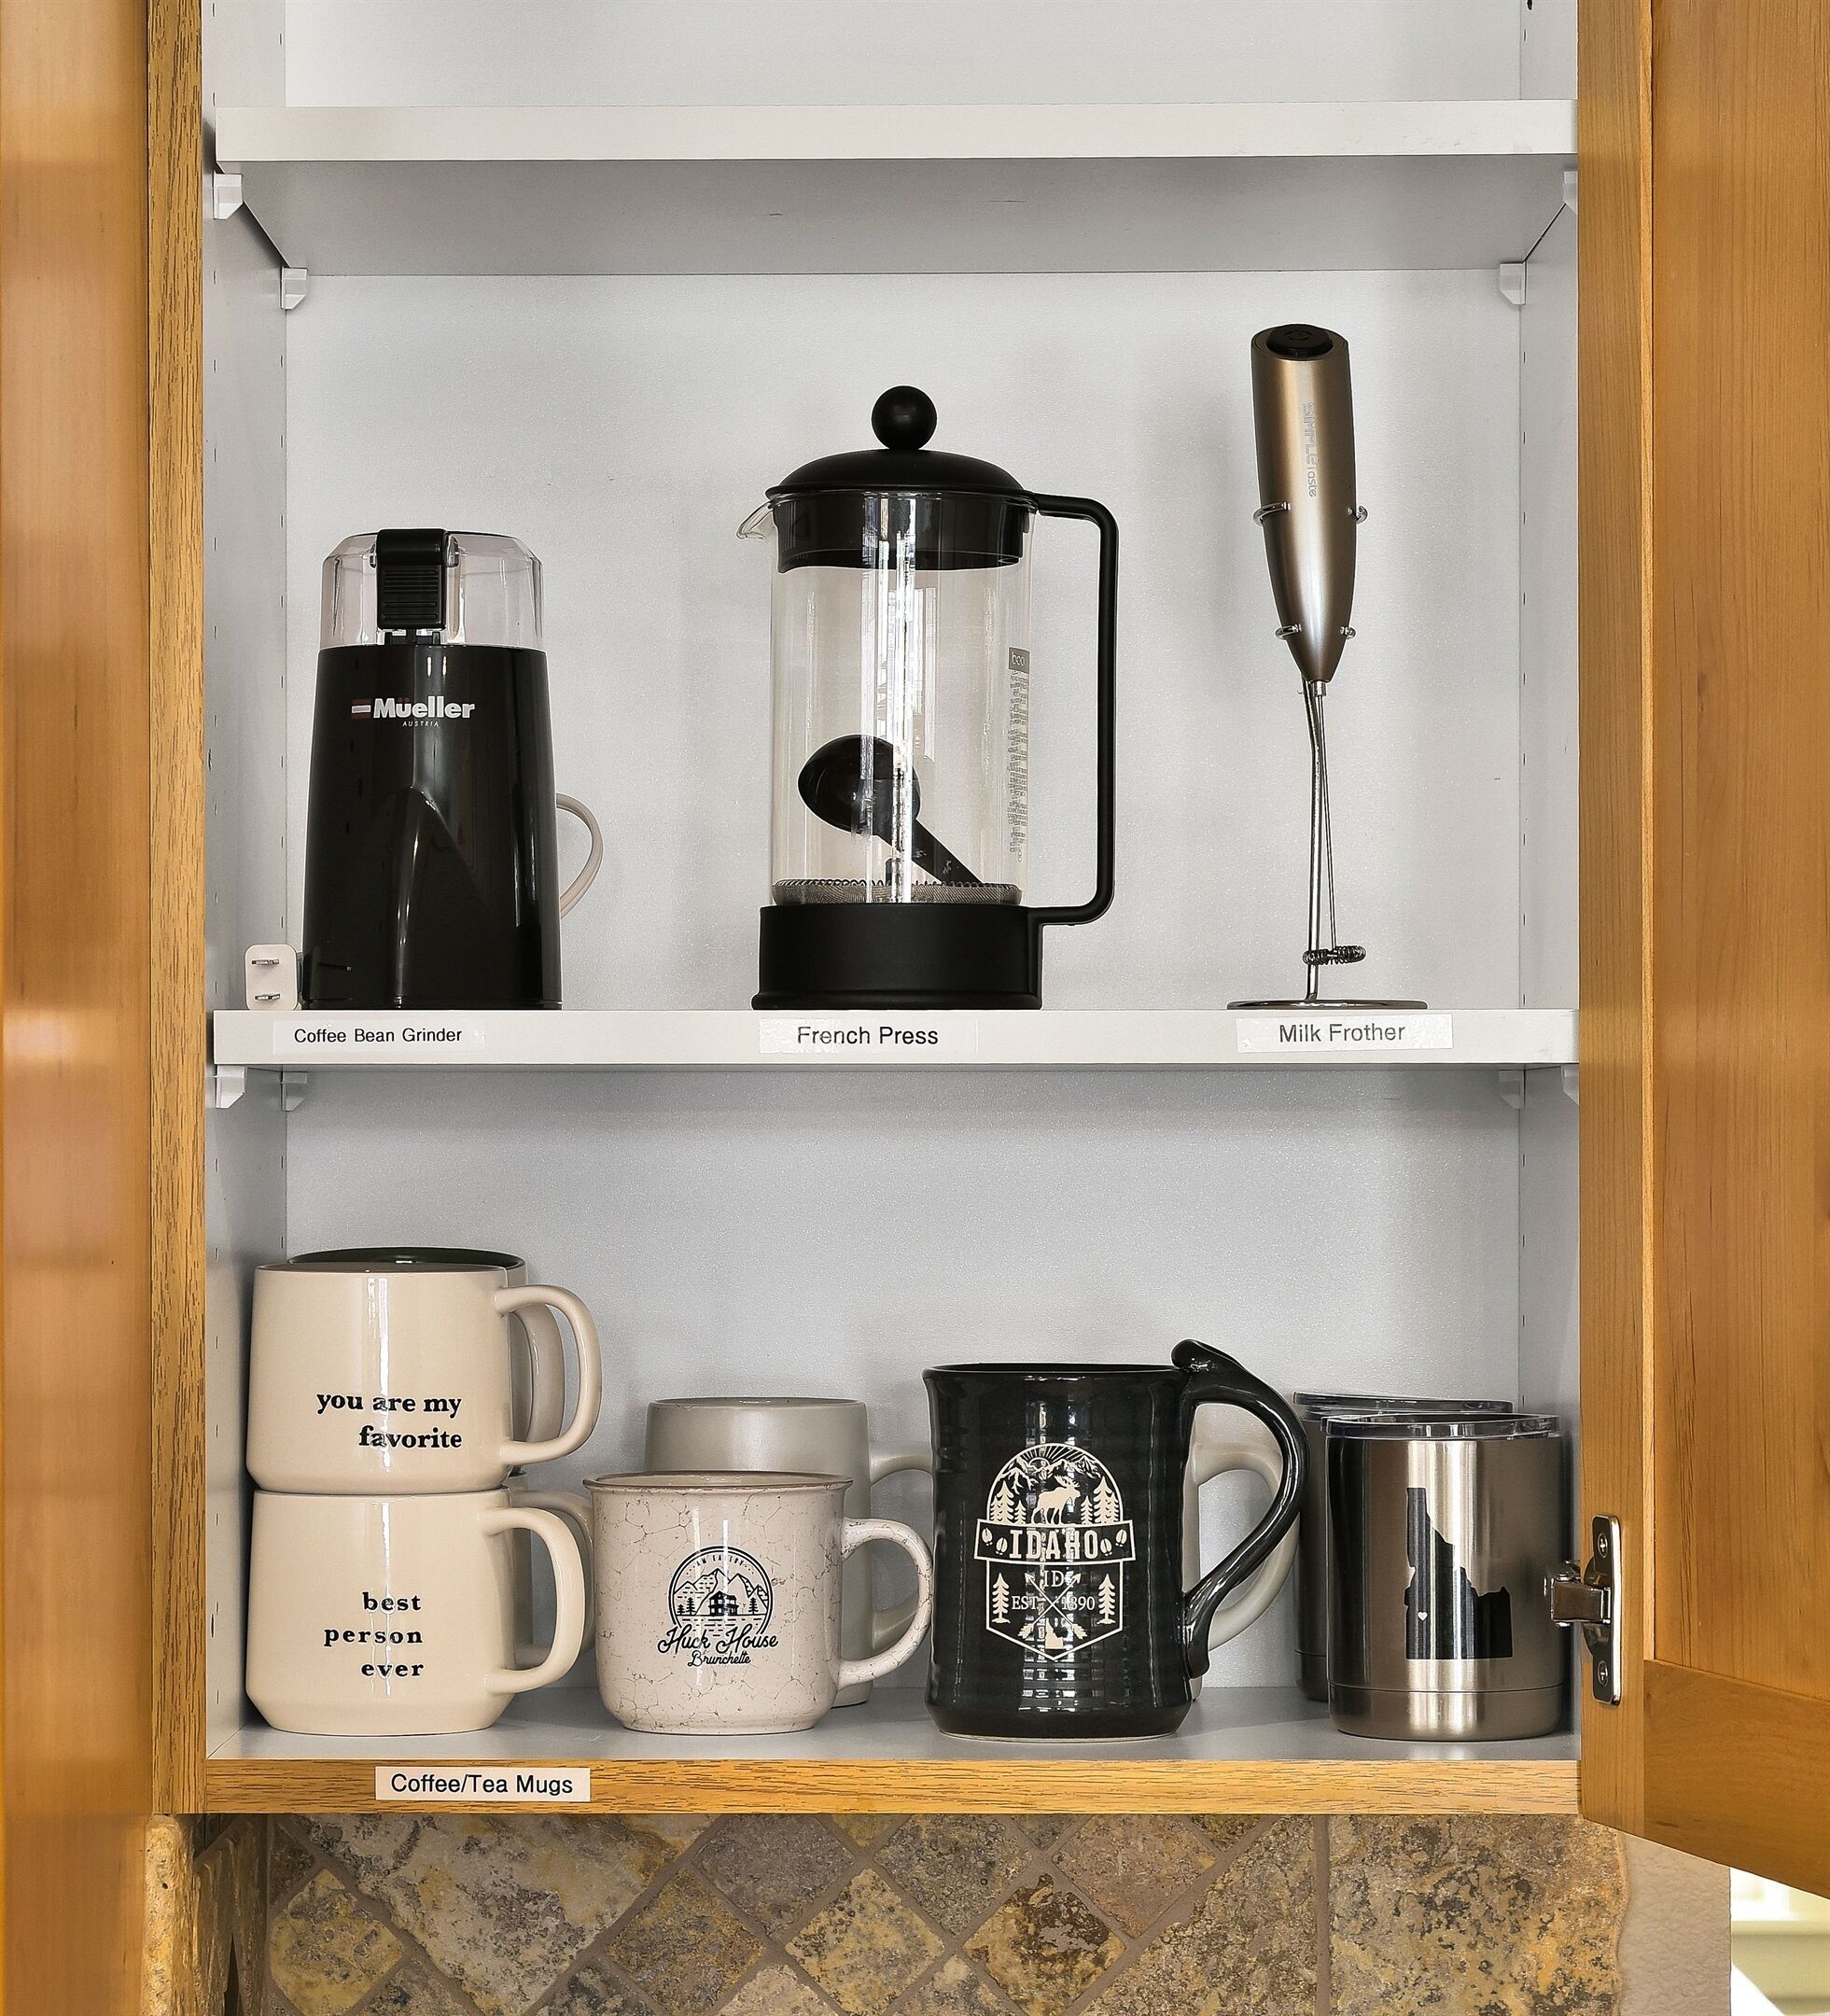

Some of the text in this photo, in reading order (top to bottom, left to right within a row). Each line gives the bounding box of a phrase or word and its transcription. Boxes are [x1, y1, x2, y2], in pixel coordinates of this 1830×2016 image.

[294, 1027, 462, 1043] Coffee Bean Grinder
[797, 1026, 939, 1045] French Press
[1279, 1022, 1405, 1043] Milk Frother
[316, 1393, 462, 1419] you are my
[358, 1424, 462, 1448] favorite
[1009, 1529, 1098, 1560] IDAHO
[1044, 1570, 1065, 1588] ID
[362, 1591, 422, 1611] best
[324, 1629, 423, 1647] person
[657, 1623, 779, 1655] Huck House
[687, 1650, 751, 1667] Brunchette
[361, 1663, 424, 1677] ever
[391, 1773, 573, 1796] Coffee/Tea Mugs
